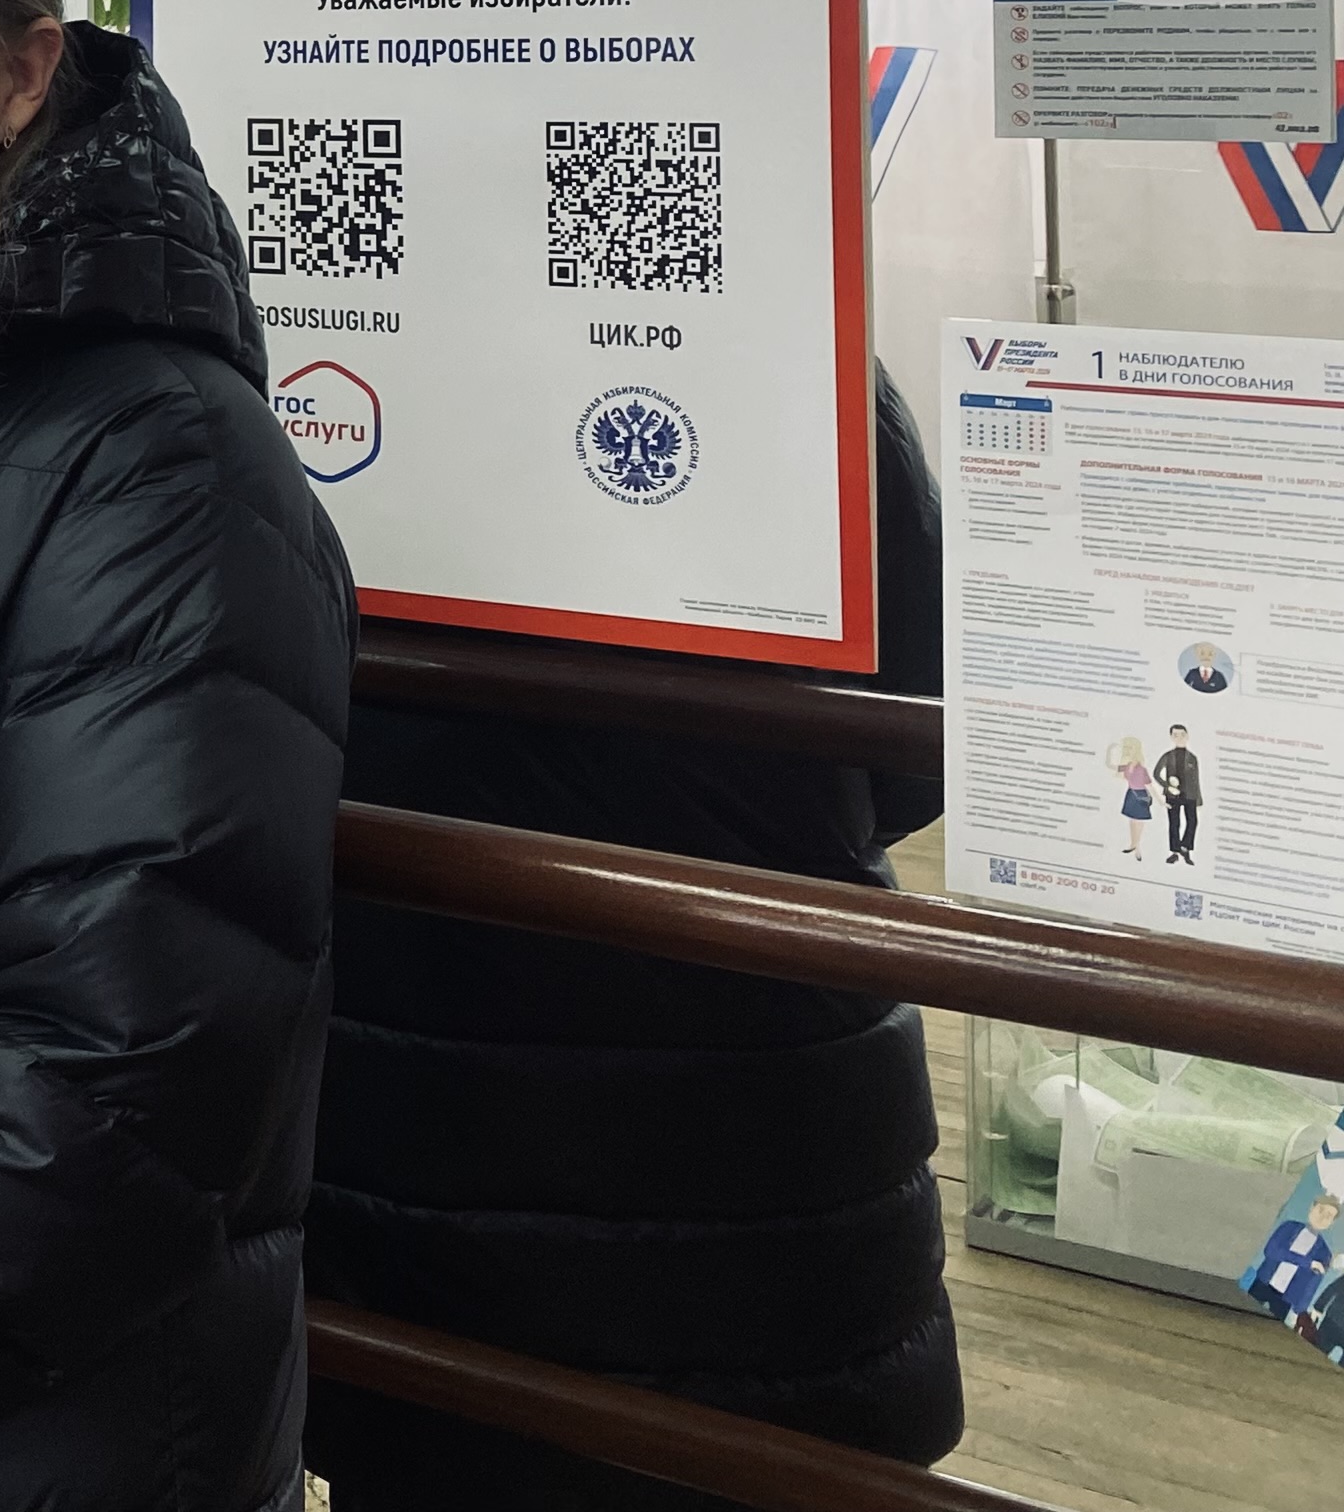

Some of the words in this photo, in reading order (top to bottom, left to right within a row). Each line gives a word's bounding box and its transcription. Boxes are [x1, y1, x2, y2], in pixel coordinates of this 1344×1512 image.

[263, 34, 370, 66] УЗНАЙТЕ
[377, 38, 532, 67] ПОДРОБНЕЕ
[539, 38, 557, 63] О
[565, 37, 696, 63] ВЫБОРАХ
[589, 321, 682, 351] ЦИК.РФ
[1008, 340, 1047, 348] ВЫБОРЫ
[1000, 358, 1034, 366] РОССИИ
[1004, 348, 1058, 358] ПРЕЗИДЕНТА
[1119, 351, 1245, 371] НАБЛЮДАТЕЛЮ
[1092, 351, 1102, 379] 1
[1119, 369, 1128, 380] В
[1132, 370, 1168, 386] ДНИ
[1172, 371, 1293, 392] ГОЛОСОВАНИЯ
[274, 396, 316, 416] гос
[576, 397, 602, 460] ЦЕНТРАЛЬНАЯ
[602, 386, 682, 414] ИЗБИРАТЕЛЬНАЯ
[679, 414, 699, 469] КОМИССИЯ
[960, 456, 1006, 465] ОСНОВНЫЕ
[960, 466, 1021, 476] ГОЛОСОВАНИЯ
[584, 466, 639, 505] РОССИЙСКАЯ
[643, 474, 692, 505] ФЕДЕРАЦИЯ
